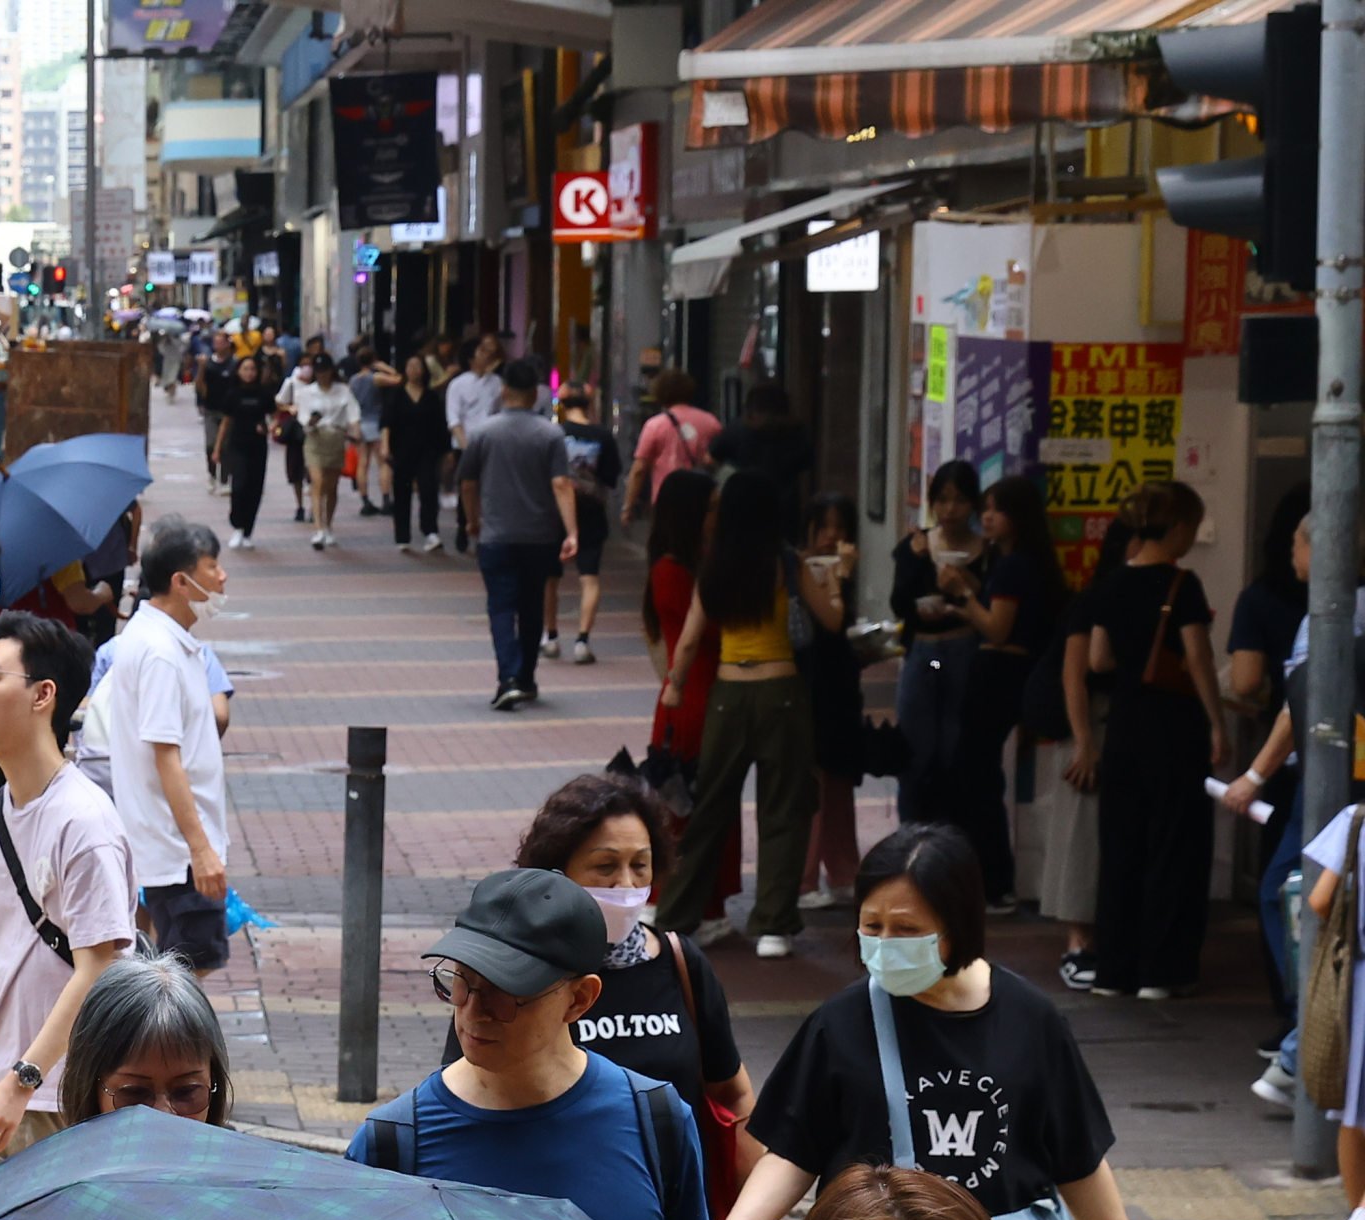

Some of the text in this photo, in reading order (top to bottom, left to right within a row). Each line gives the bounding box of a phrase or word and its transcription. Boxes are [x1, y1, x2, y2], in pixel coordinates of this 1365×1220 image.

[574, 189, 602, 219] K
[1053, 345, 1166, 368] TML
[576, 1013, 682, 1043] DOLTON
